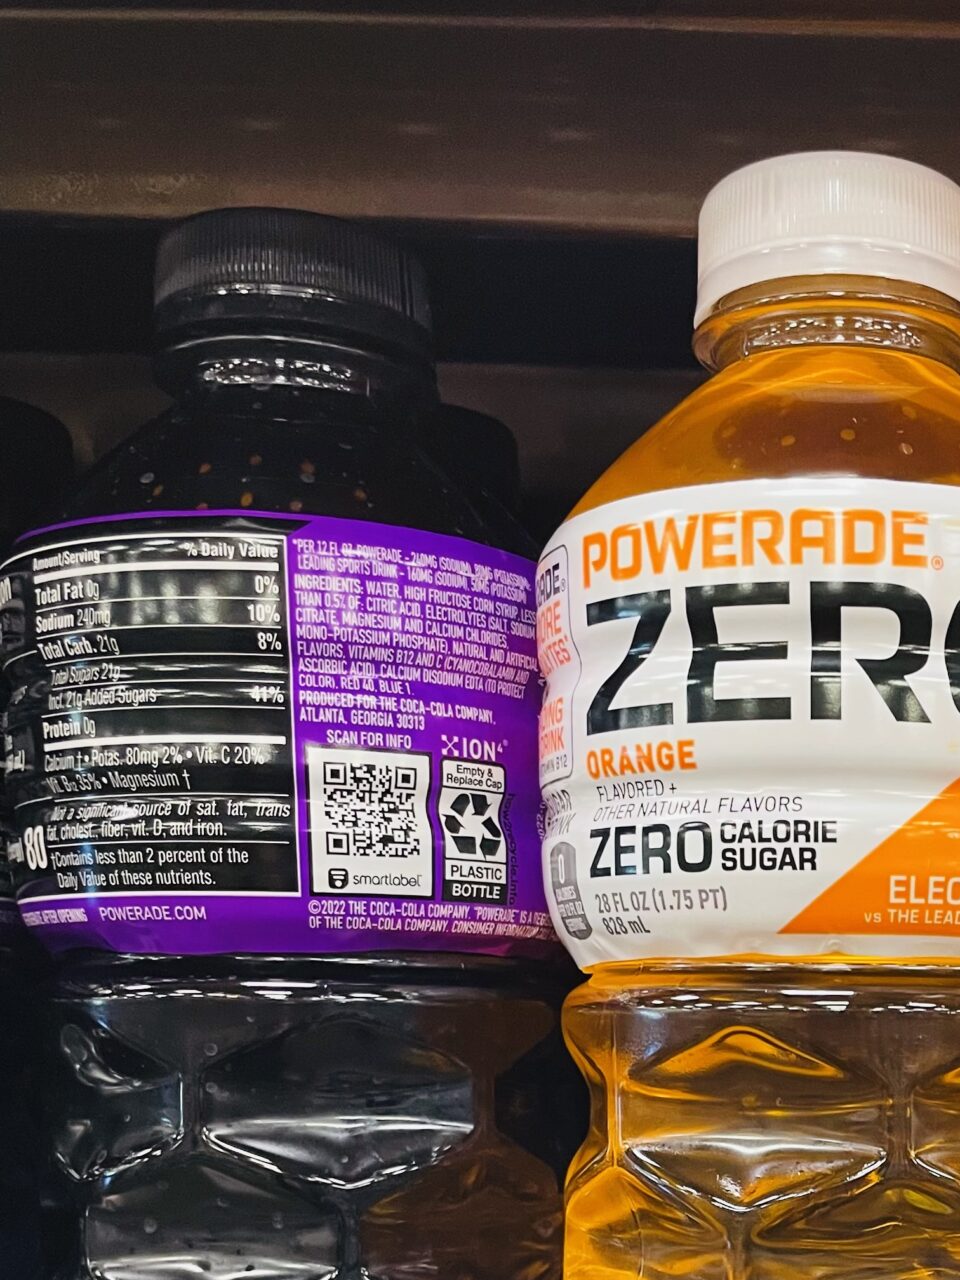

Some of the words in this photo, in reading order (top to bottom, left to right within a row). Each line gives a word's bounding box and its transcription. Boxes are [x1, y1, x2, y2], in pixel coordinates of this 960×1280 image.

[583, 508, 929, 589] POWERADE
[35, 588, 61, 605] Total
[64, 582, 84, 599] Fat
[86, 580, 99, 599] 0g
[255, 575, 279, 594] 0%
[36, 612, 74, 633] Sodium
[77, 609, 110, 627] 240mg
[249, 604, 281, 623] 10%
[300, 706, 347, 726] ATLANTA,
[351, 711, 393, 728] GEORGIA
[396, 714, 425, 730] 30313
[327, 730, 359, 745] SCAN
[361, 732, 384, 747] FOR
[386, 734, 411, 749] INFO
[586, 740, 697, 779] ORANGE
[597, 779, 664, 802] FLAVORED
[594, 803, 634, 822] OTHER
[637, 799, 711, 818] NATURAL
[719, 796, 803, 813] FLAVORS
[720, 820, 838, 843] CALORIE
[590, 821, 712, 878] ZERO
[721, 847, 817, 871] SUGAR
[353, 873, 420, 887] smartlabel
[451, 865, 503, 880] PLASTIC
[452, 884, 501, 899] BOTTLE
[595, 893, 611, 913] 28
[614, 892, 628, 912] FL
[630, 891, 650, 912] OZ
[652, 888, 693, 913] (1.75
[700, 886, 727, 911] PT)
[100, 906, 206, 921] POWERADE.COM
[603, 917, 627, 935] 828
[630, 915, 650, 934] mL
[888, 909, 918, 924] THE
